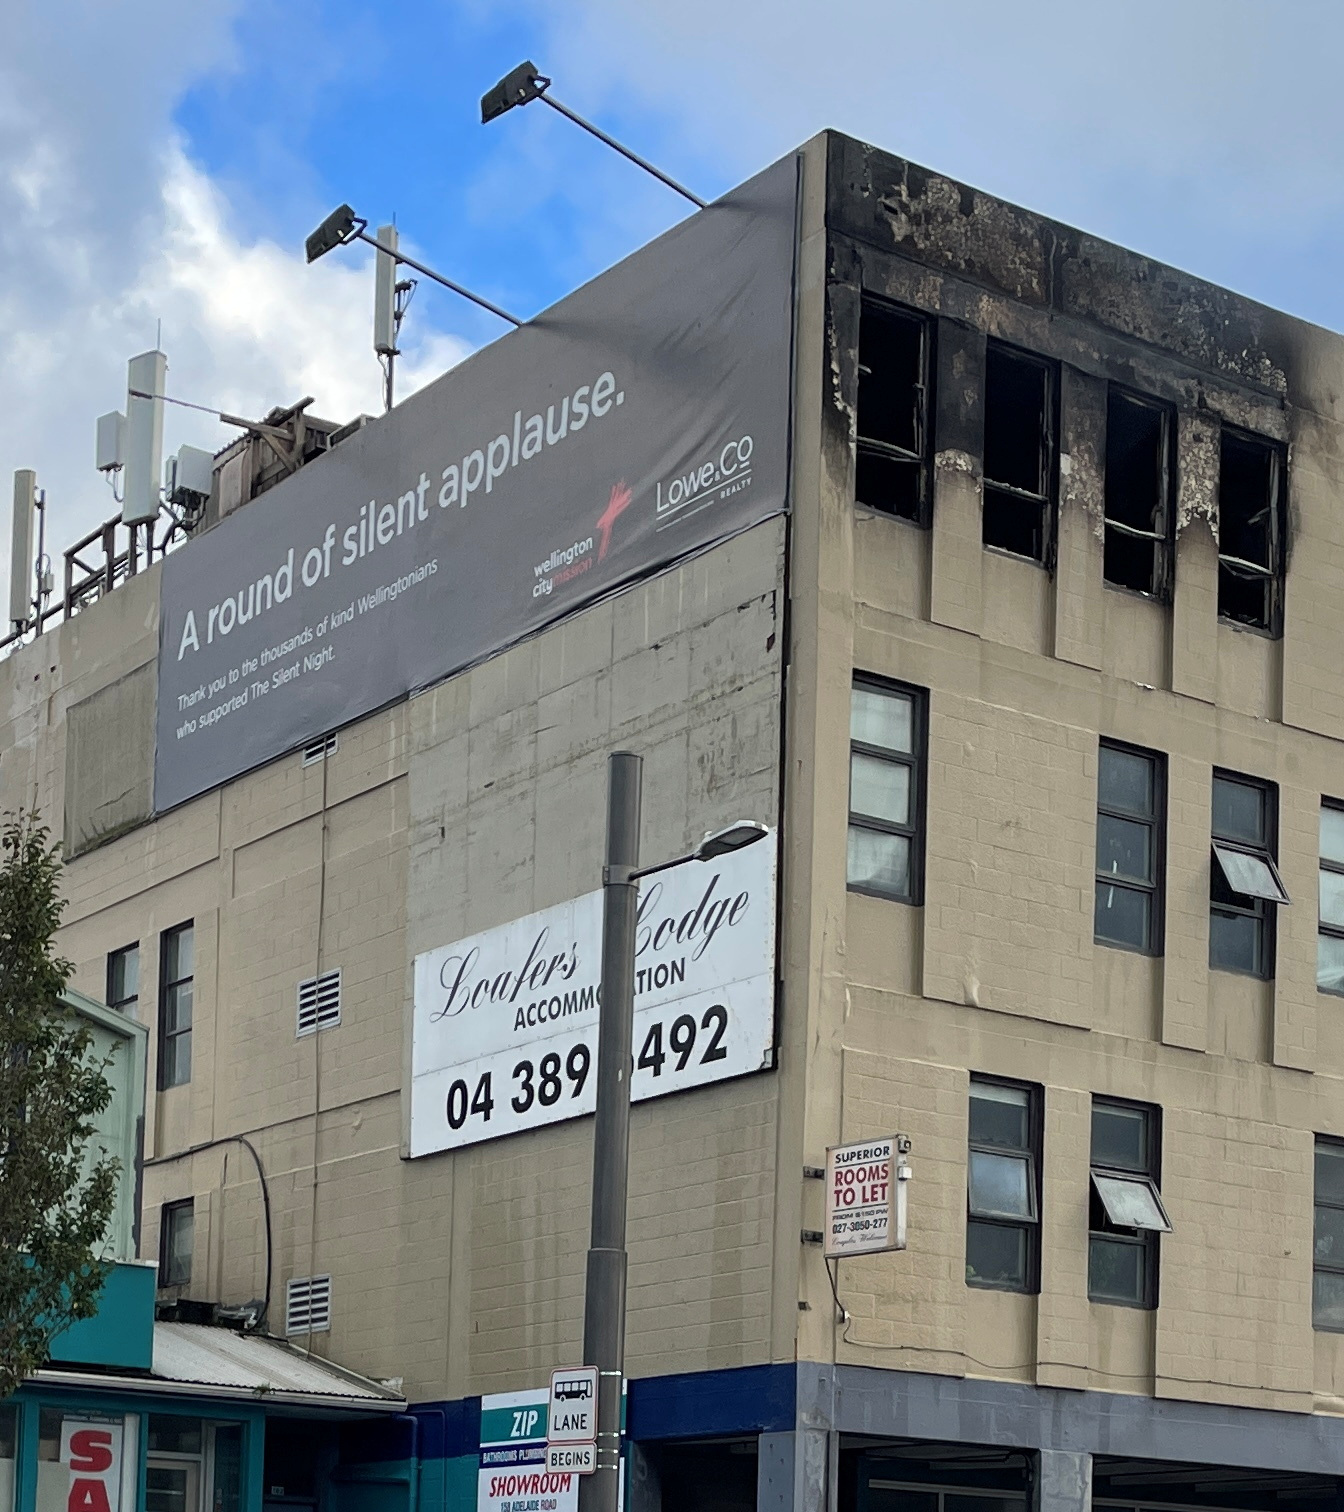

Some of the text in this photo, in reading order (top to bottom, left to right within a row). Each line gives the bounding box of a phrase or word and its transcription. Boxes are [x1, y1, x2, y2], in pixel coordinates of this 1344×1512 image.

[720, 477, 752, 499] REALTY
[178, 371, 625, 661] A round of silent applause.
[534, 536, 593, 578] wellington
[177, 558, 439, 711] Thank you to the thousands of kind Wellingtonians
[176, 643, 336, 739] who supported The Silent Night.
[429, 926, 583, 1023] Loafers
[513, 957, 686, 1032] ACCOMMTION
[446, 1004, 729, 1130] 04 389 492
[835, 1146, 890, 1164] SUPERIOR
[834, 1163, 889, 1187] ROOMS
[834, 1183, 889, 1207] TO LET
[510, 1410, 539, 1438] ZIP
[553, 1413, 588, 1431] LANE
[550, 1451, 591, 1467] BEGINS
[489, 1474, 572, 1498] SHOWROOM
[511, 1500, 540, 1512] ADELAIDE
[540, 1498, 558, 1512] ROAD
